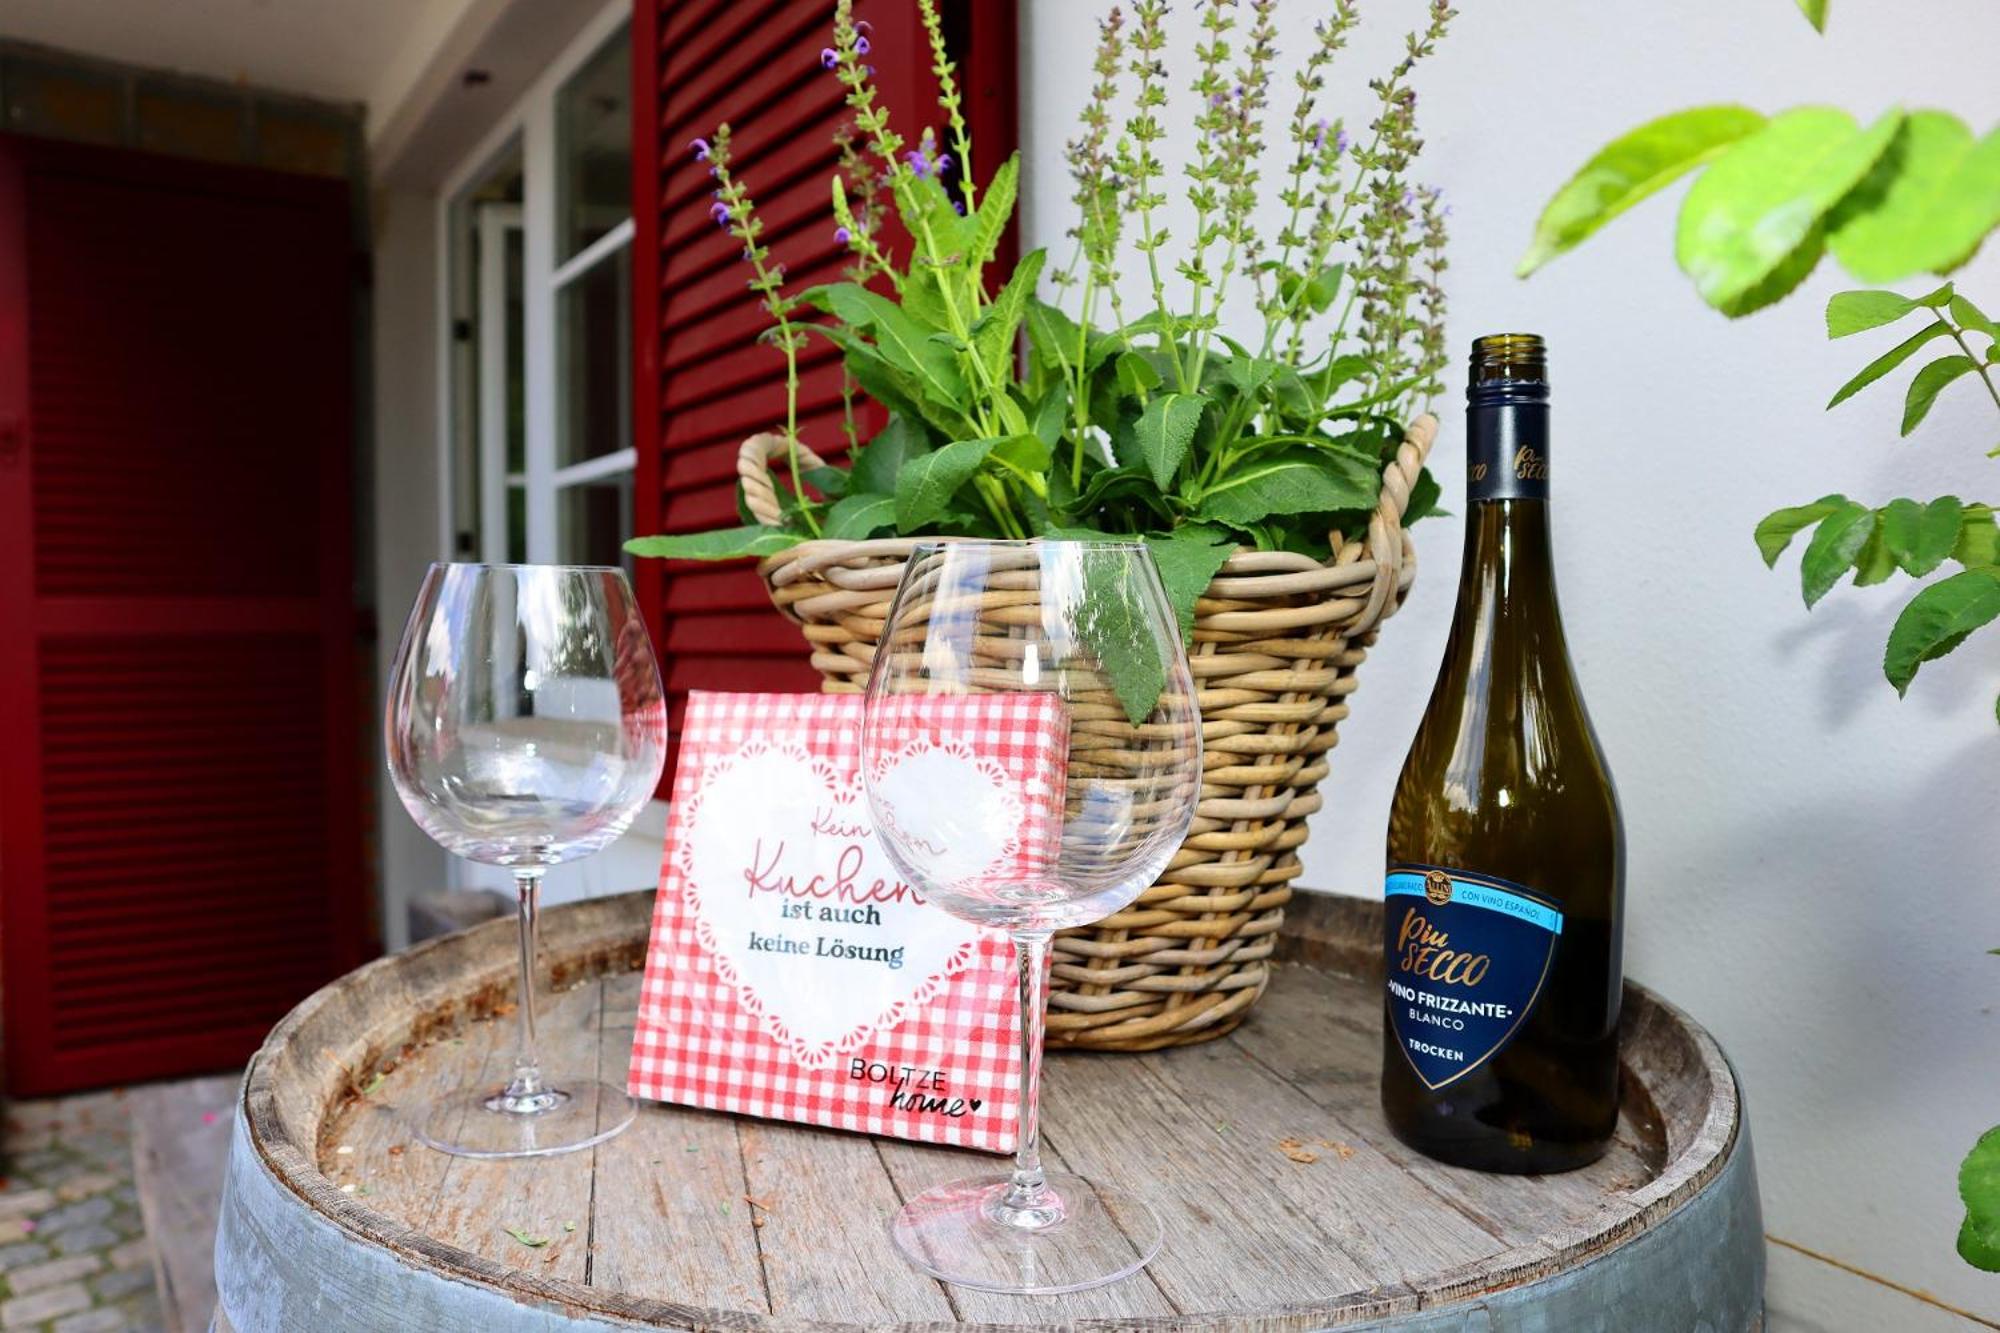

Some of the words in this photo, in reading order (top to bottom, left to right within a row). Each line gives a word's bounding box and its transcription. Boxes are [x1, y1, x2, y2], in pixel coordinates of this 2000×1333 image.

[810, 806, 872, 837] Kein
[744, 838, 927, 905] Kuchen
[781, 898, 812, 920] ist
[819, 903, 881, 925] auch
[1461, 889, 1480, 902] CON
[1482, 895, 1504, 907] VINO
[748, 931, 810, 955] keine
[816, 937, 904, 969] Lösung
[1401, 943, 1490, 986] SECCO
[1408, 1008, 1465, 1031] BLANCO
[1408, 1038, 1464, 1061] TROCKEN
[850, 1058, 946, 1092] BOLTZE
[888, 1077, 968, 1118] home
